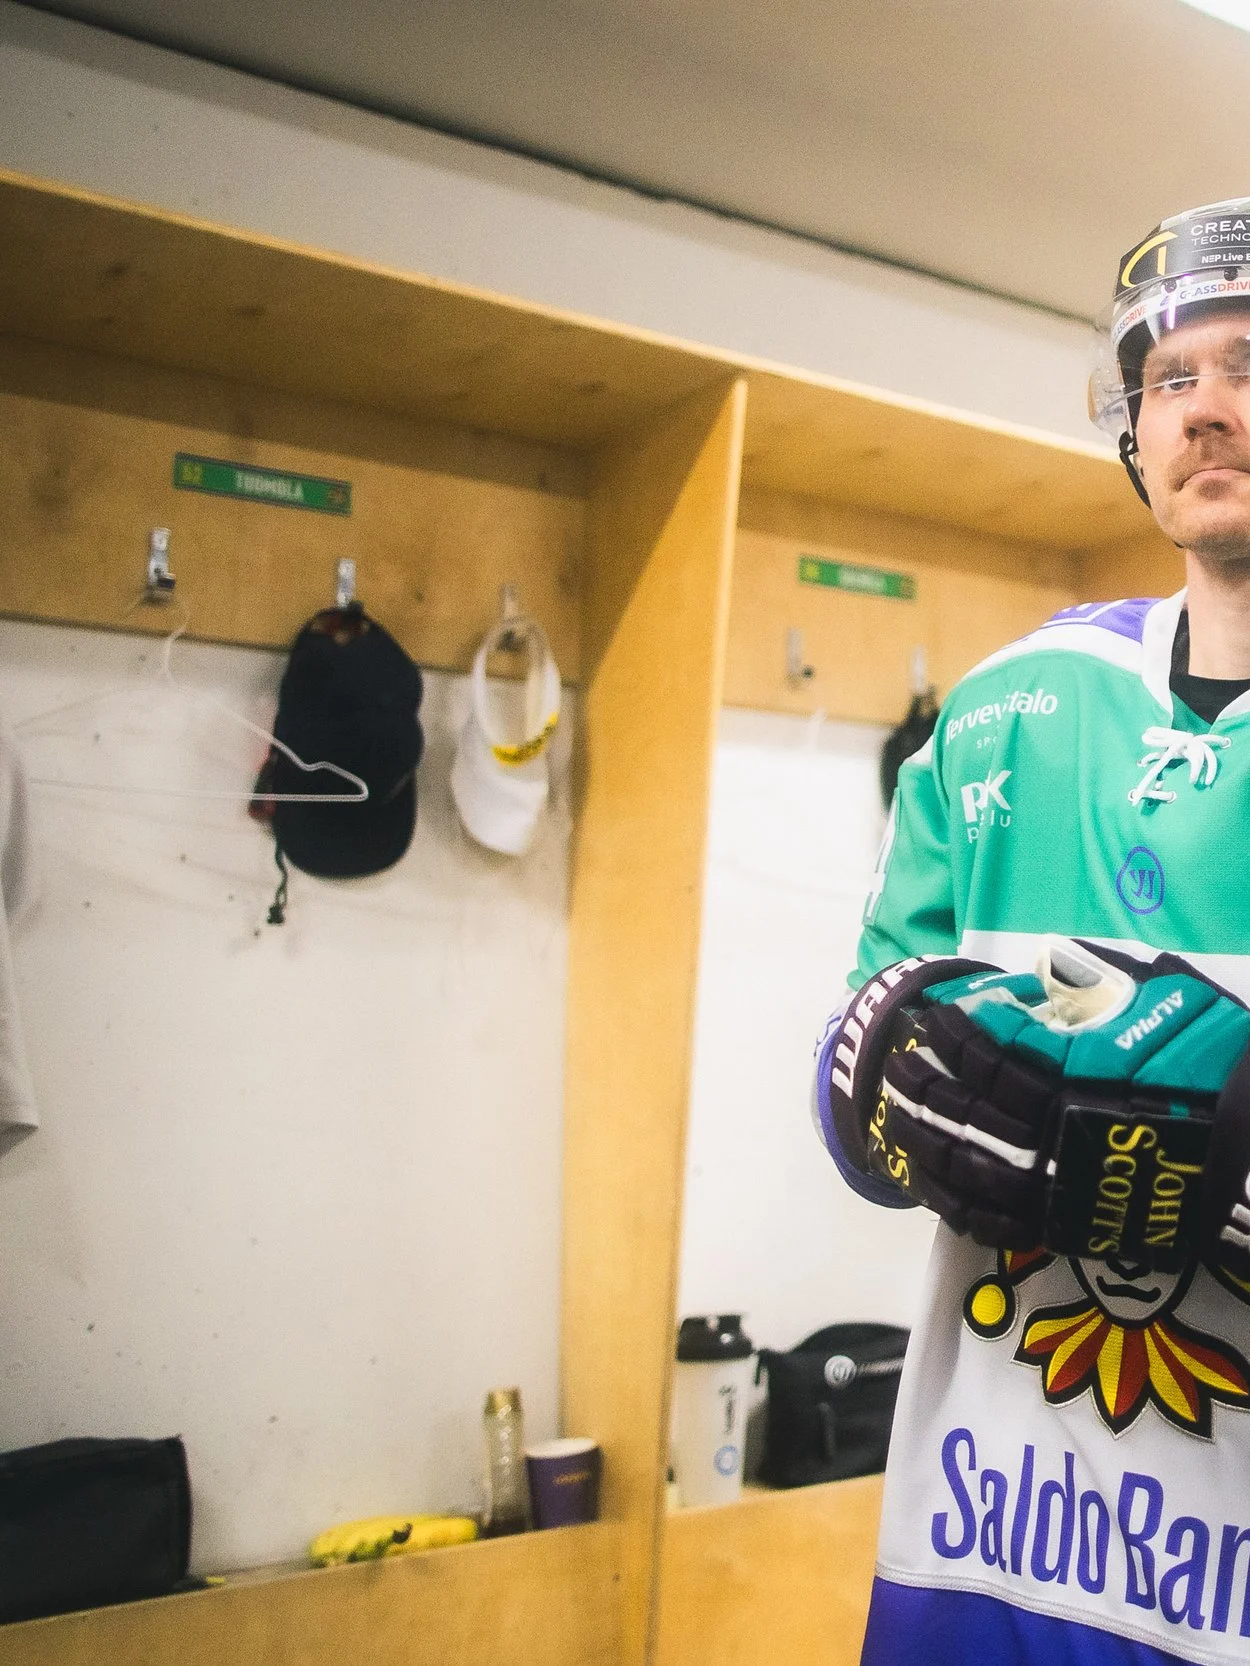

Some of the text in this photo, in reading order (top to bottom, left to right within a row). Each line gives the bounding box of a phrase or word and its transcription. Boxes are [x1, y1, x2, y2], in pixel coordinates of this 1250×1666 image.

[1201, 254, 1221, 264] NEP
[1222, 252, 1244, 262] Live
[1114, 988, 1185, 1052] ALPHA
[1143, 1148, 1206, 1250] JOHN
